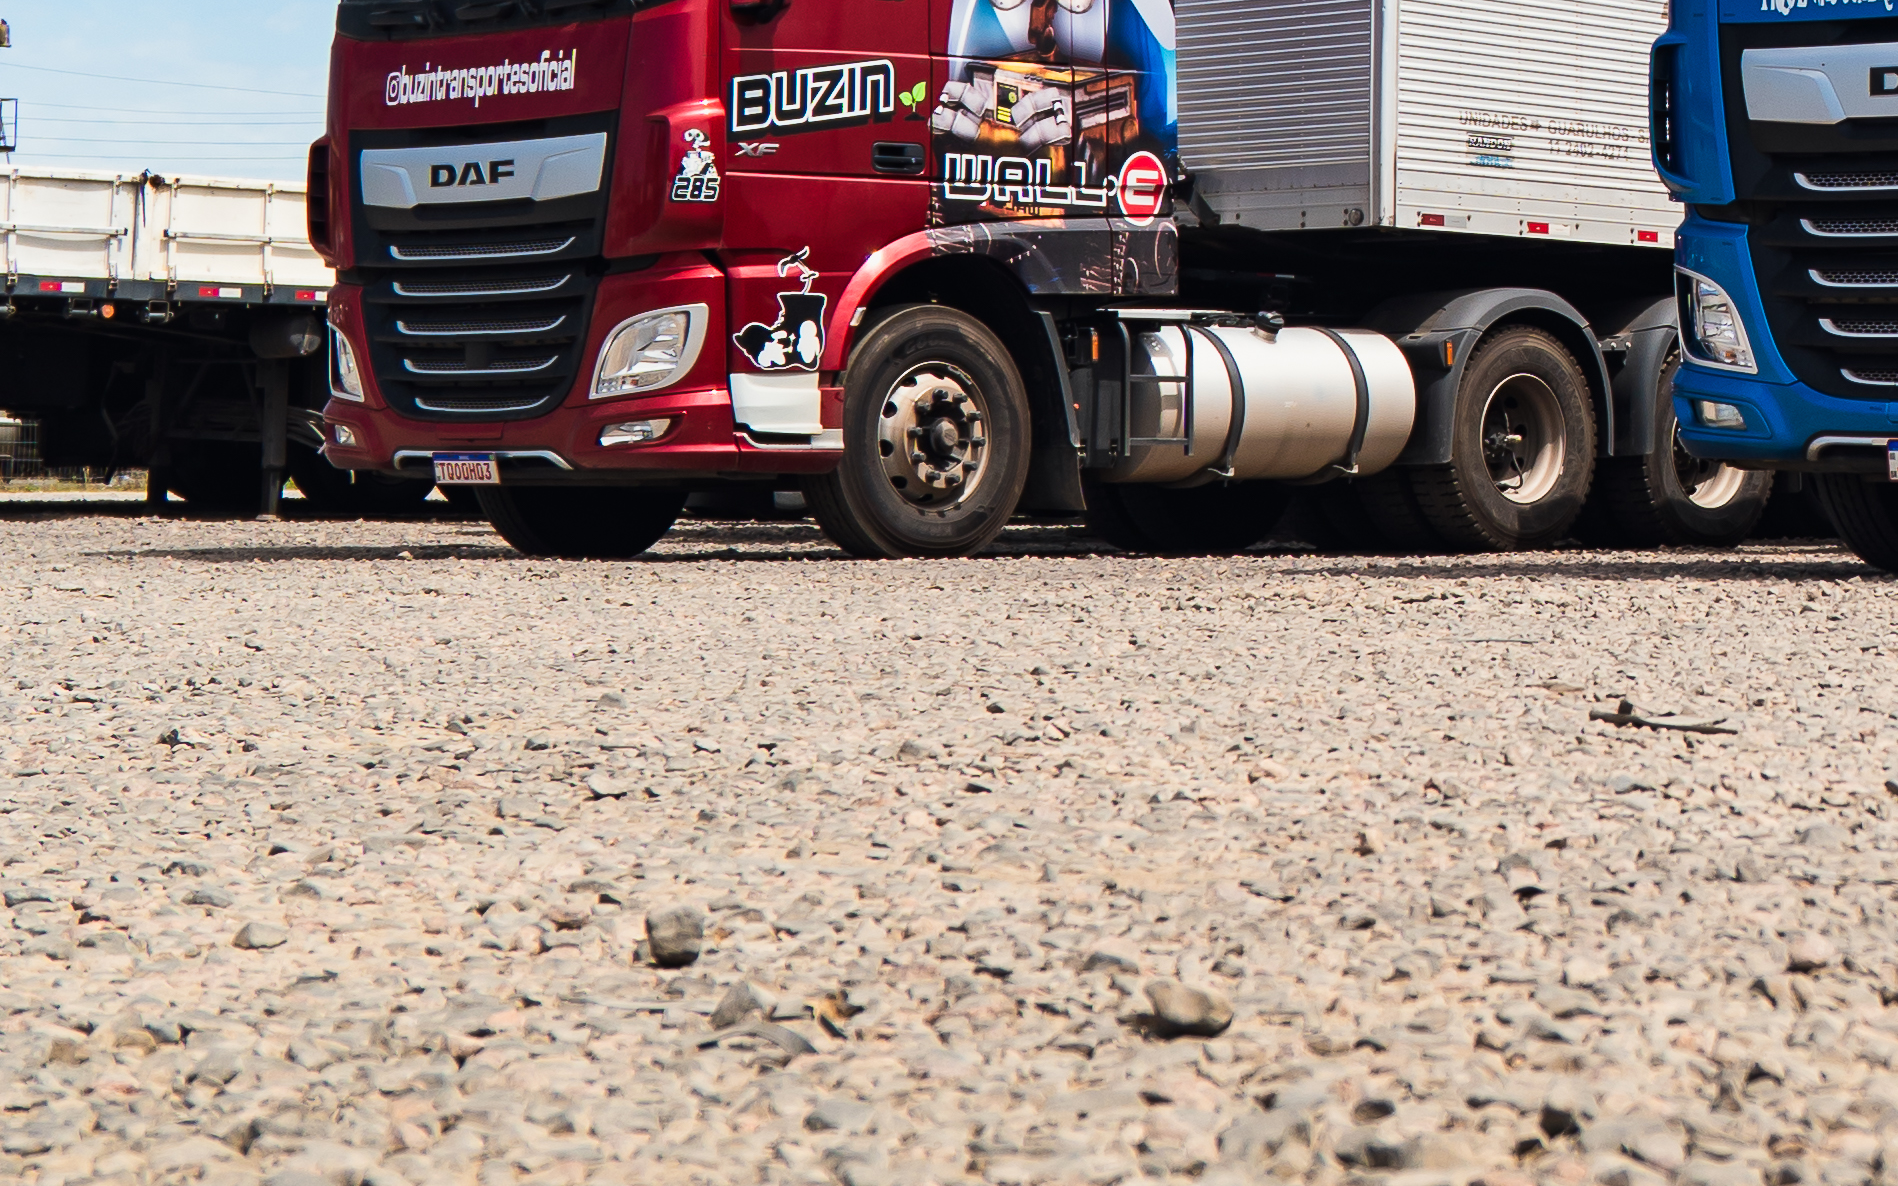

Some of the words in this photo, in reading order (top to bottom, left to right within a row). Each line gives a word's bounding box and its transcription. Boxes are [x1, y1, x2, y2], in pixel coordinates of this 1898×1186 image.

[730, 59, 895, 134] BUZIN
[1459, 110, 1528, 131] UNIDADES
[735, 142, 780, 157] XF
[429, 158, 515, 188] DAF
[672, 175, 721, 202] 285
